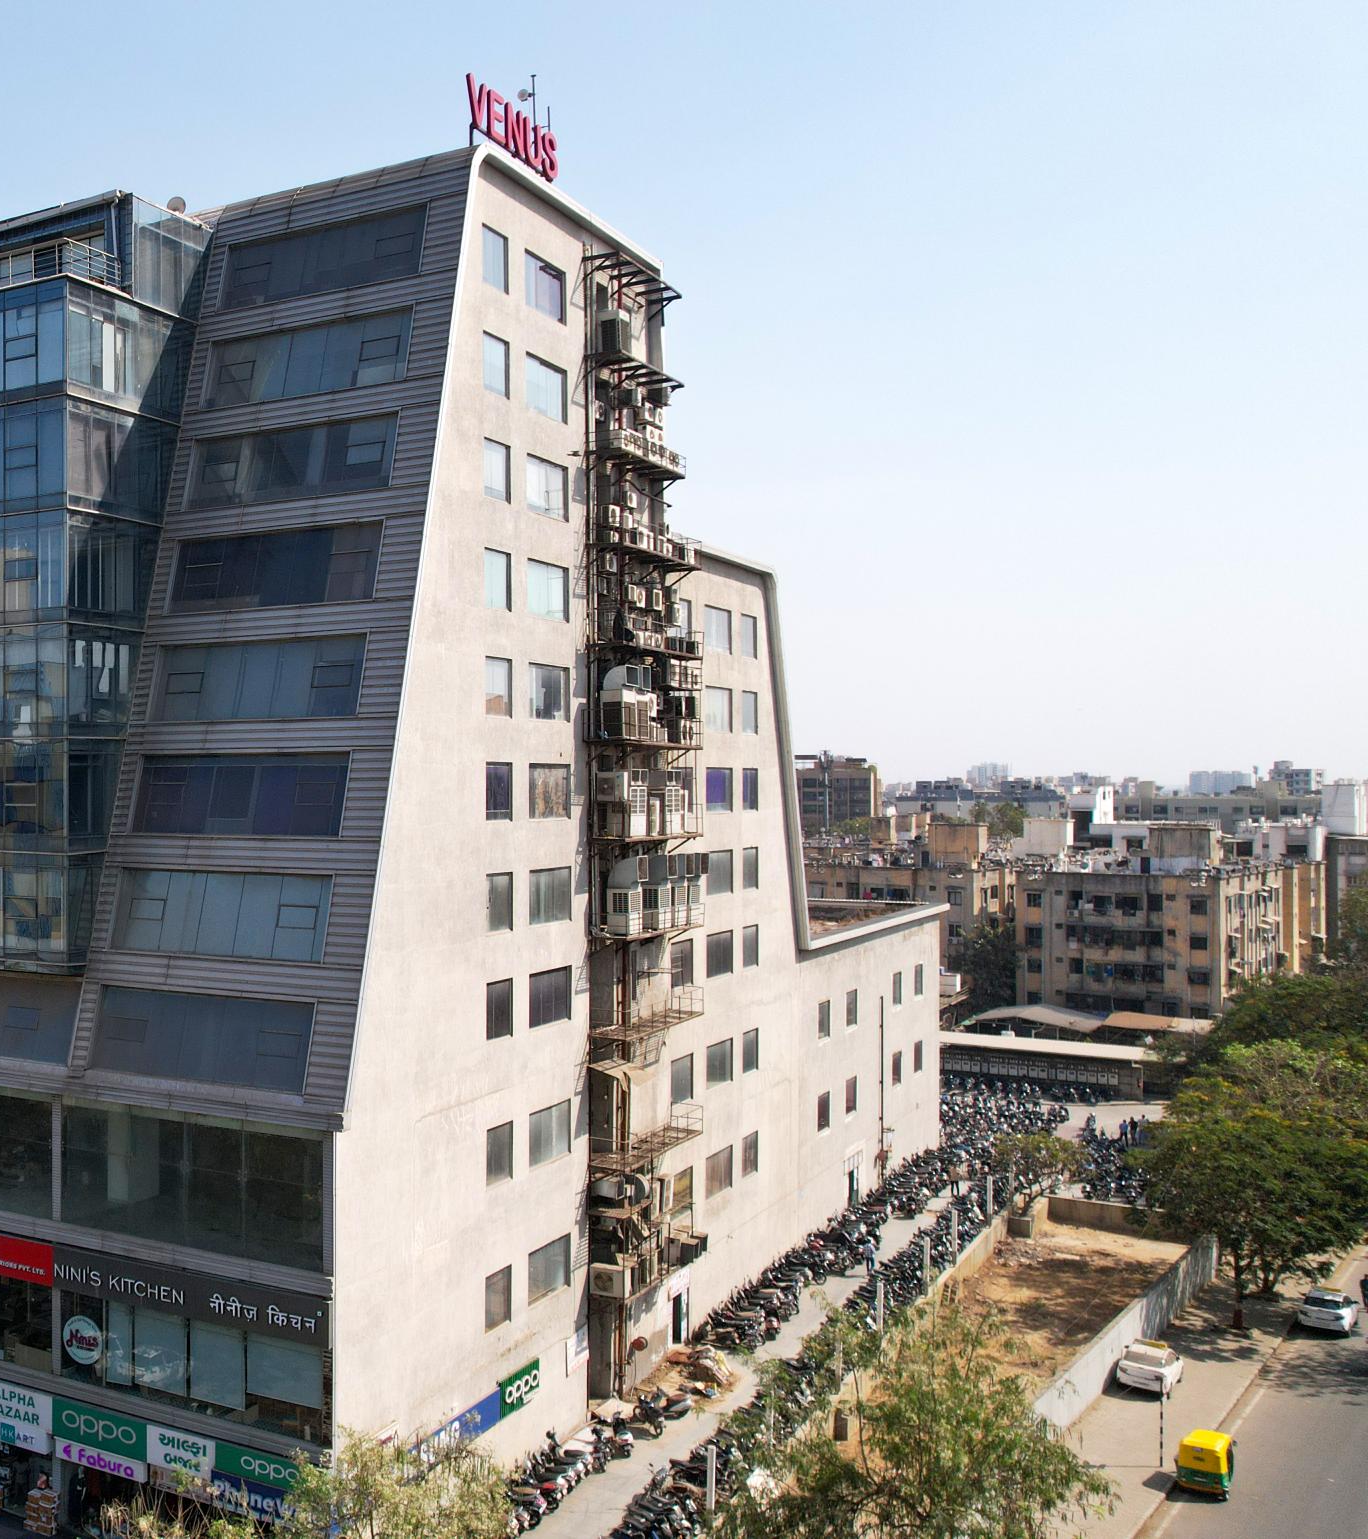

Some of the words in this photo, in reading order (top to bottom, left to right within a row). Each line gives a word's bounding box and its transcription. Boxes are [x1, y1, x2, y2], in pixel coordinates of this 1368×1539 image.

[466, 73, 559, 180] VENUS
[18, 1263, 31, 1272] PVT.
[54, 1263, 101, 1287] NINI'S
[109, 1275, 184, 1305] KITCHEN
[266, 1305, 316, 1334] किचन
[505, 1369, 540, 1405] oppo
